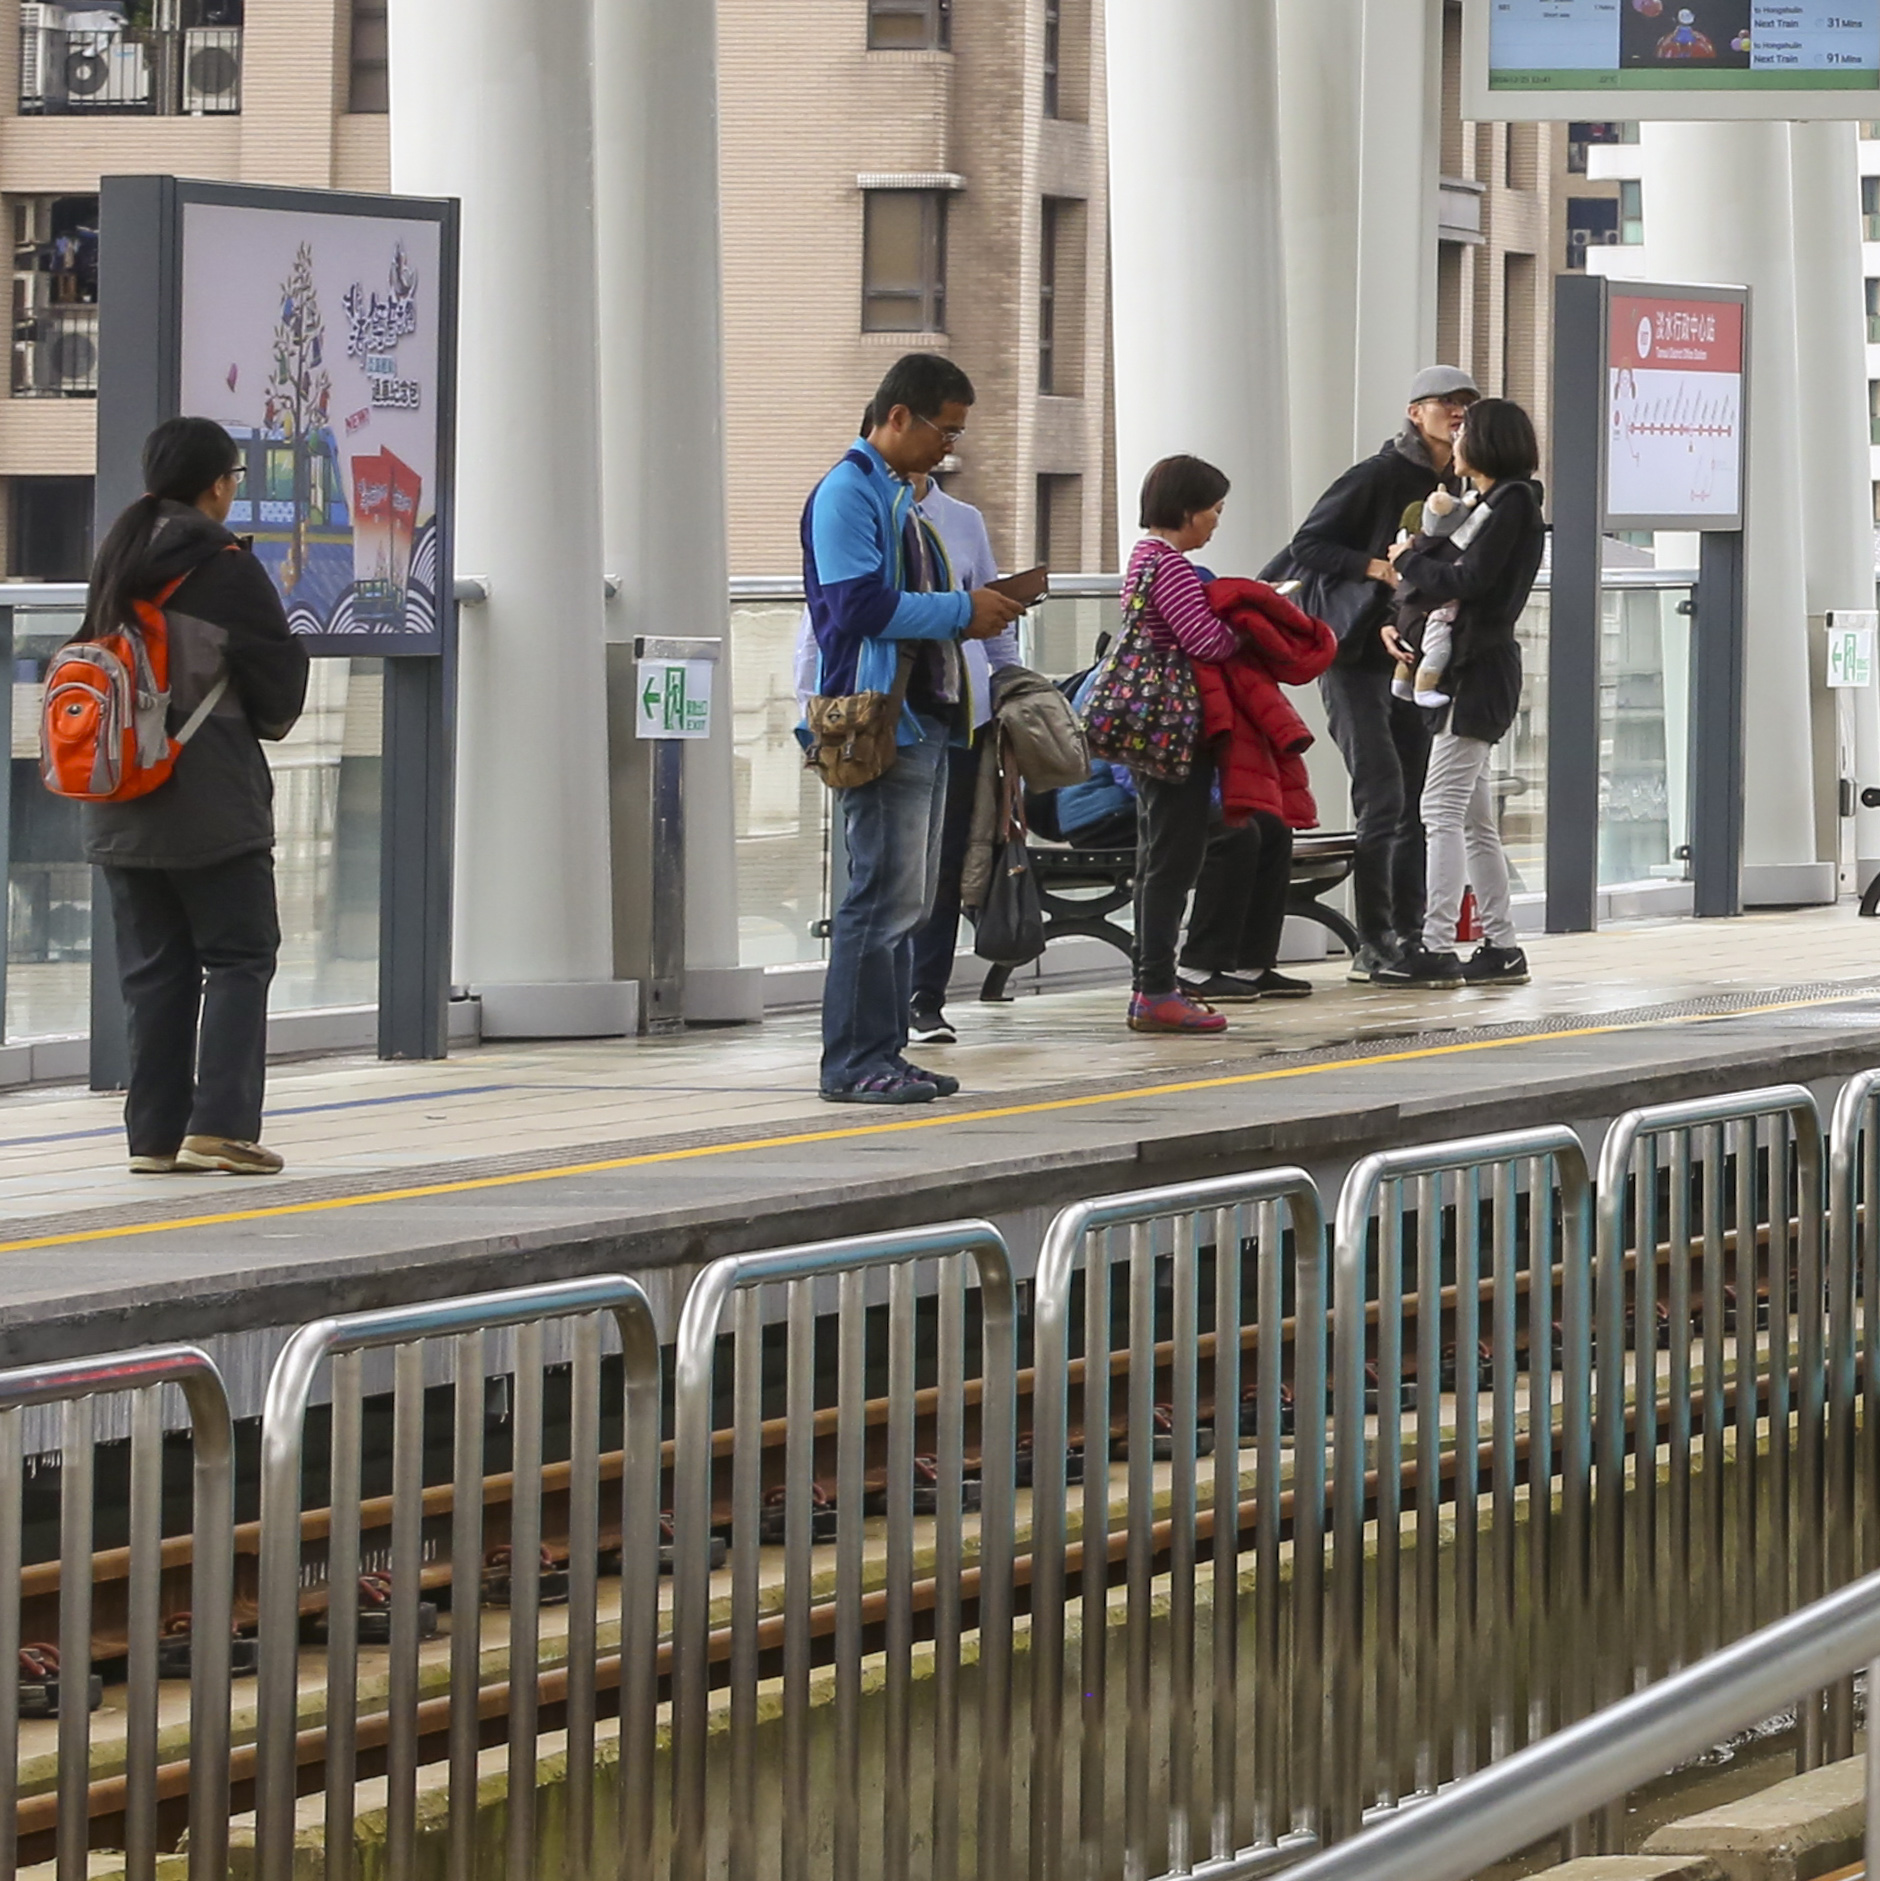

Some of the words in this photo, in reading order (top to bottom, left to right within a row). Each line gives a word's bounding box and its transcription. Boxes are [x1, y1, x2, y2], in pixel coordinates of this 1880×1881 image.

[1754, 20, 1775, 28] Next
[1777, 19, 1798, 28] Train
[1753, 55, 1774, 63] Next
[1776, 55, 1798, 63] Train
[1656, 311, 1715, 342] 淡水行政中心站
